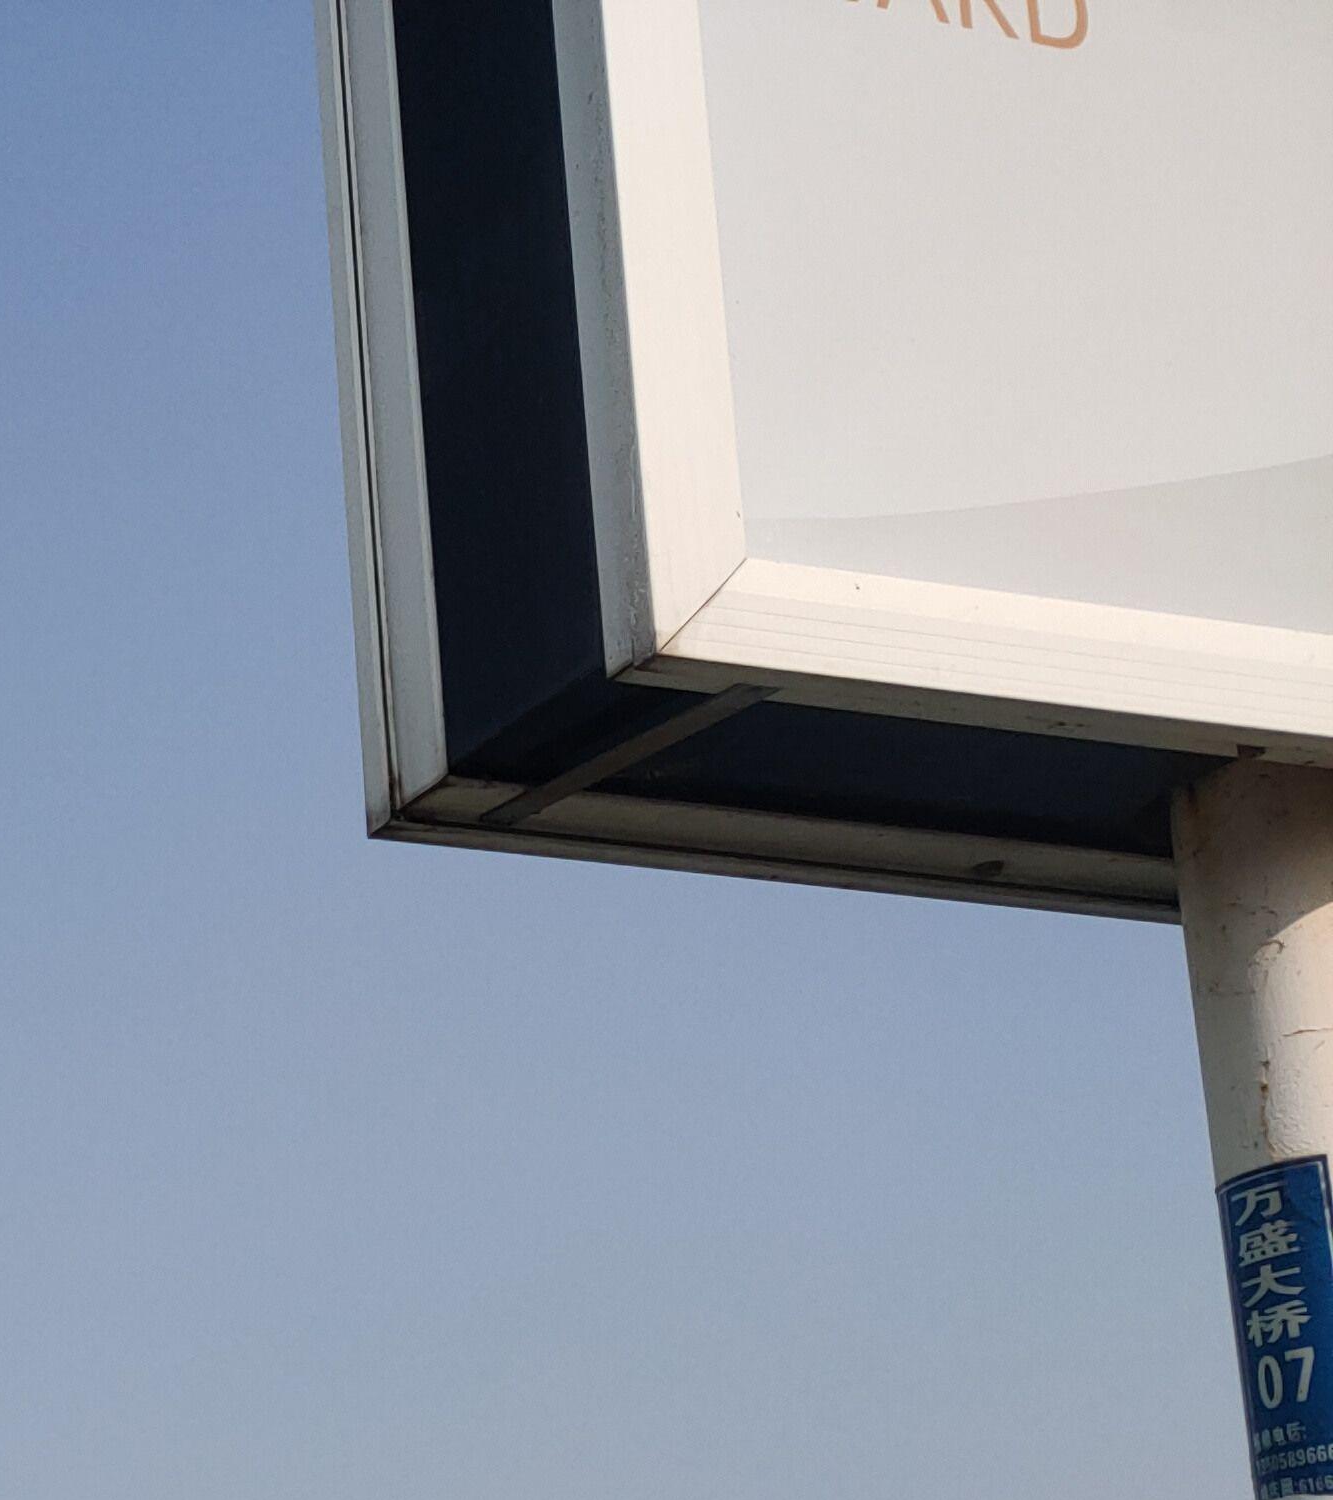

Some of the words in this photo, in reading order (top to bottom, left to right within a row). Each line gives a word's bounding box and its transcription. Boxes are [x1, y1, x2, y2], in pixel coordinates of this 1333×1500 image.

[1231, 1182, 1312, 1348] 万盛大桥
[1257, 1346, 1315, 1410] 07
